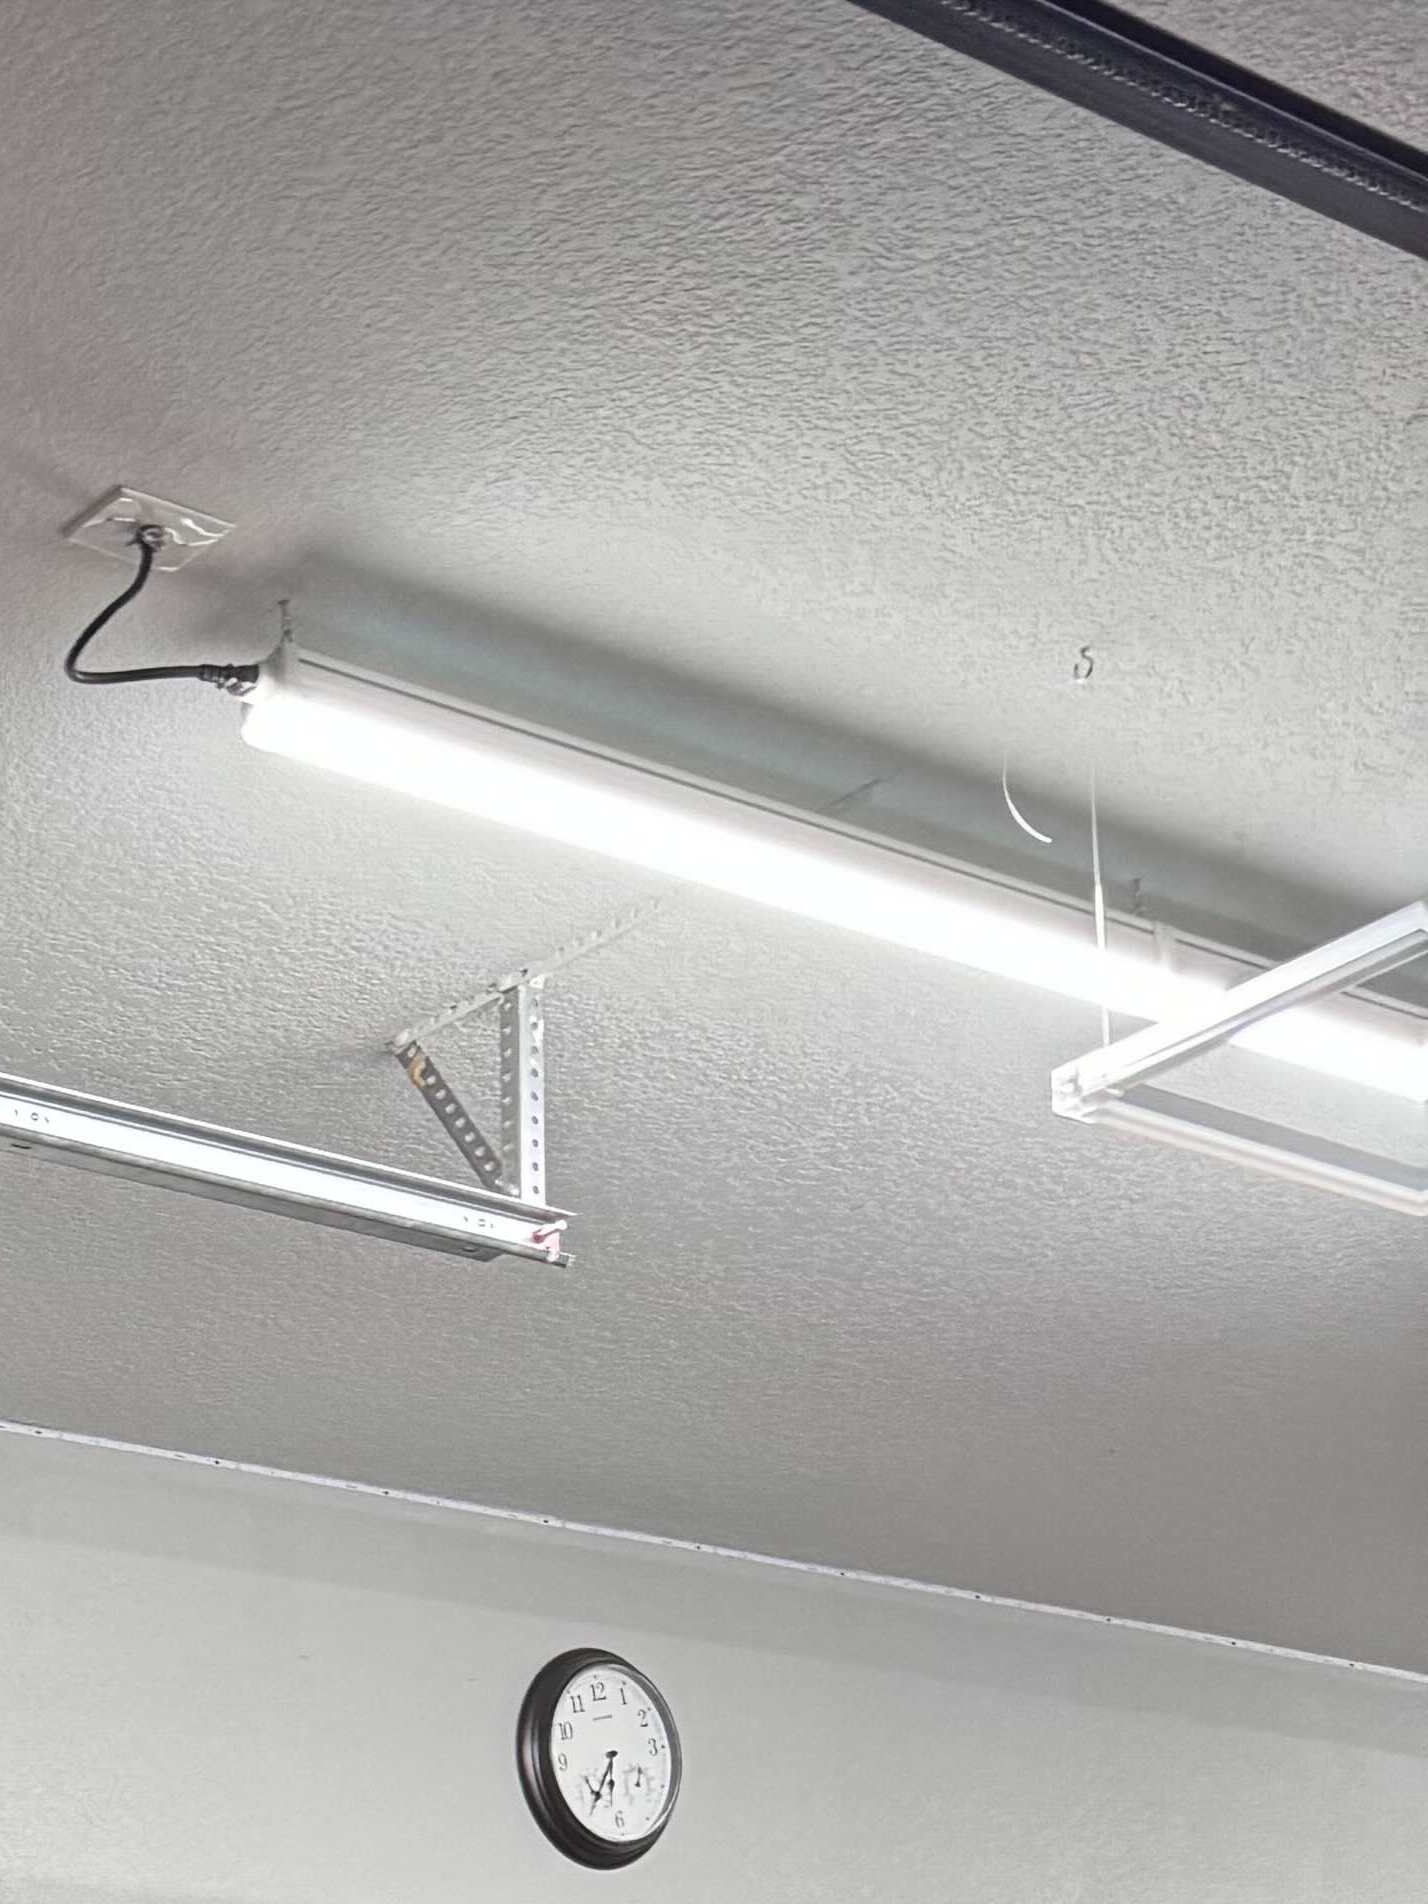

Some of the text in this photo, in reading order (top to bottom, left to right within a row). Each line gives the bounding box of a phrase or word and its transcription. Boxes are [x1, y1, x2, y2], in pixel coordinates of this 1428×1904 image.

[589, 1682, 607, 1702] 12
[620, 1688, 628, 1705] 1
[570, 1695, 585, 1714] 11
[637, 1709, 649, 1728] 2
[558, 1721, 574, 1741] 10
[648, 1738, 659, 1757] 3
[557, 1753, 568, 1772] 9
